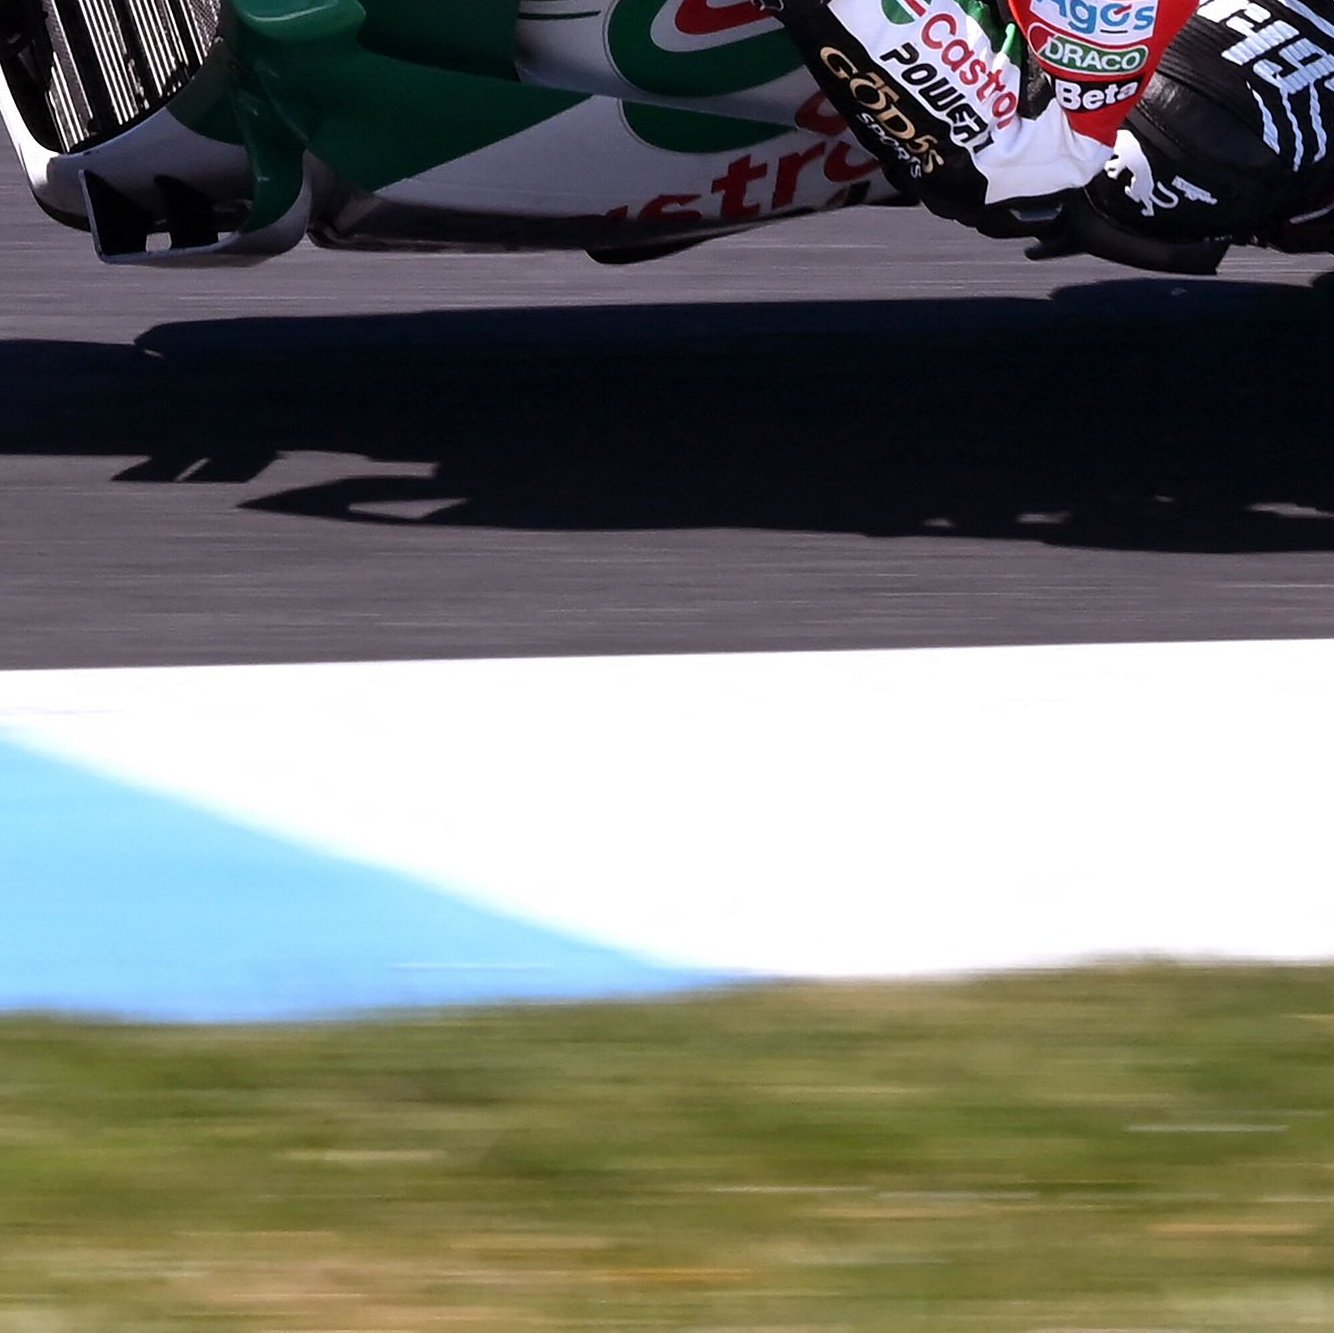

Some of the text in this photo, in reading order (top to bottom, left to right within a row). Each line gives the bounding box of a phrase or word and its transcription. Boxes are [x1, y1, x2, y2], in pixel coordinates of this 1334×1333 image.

[920, 12, 1019, 130] Castrol
[1044, 35, 1141, 71] DRACO
[1055, 78, 1139, 112] Beta
